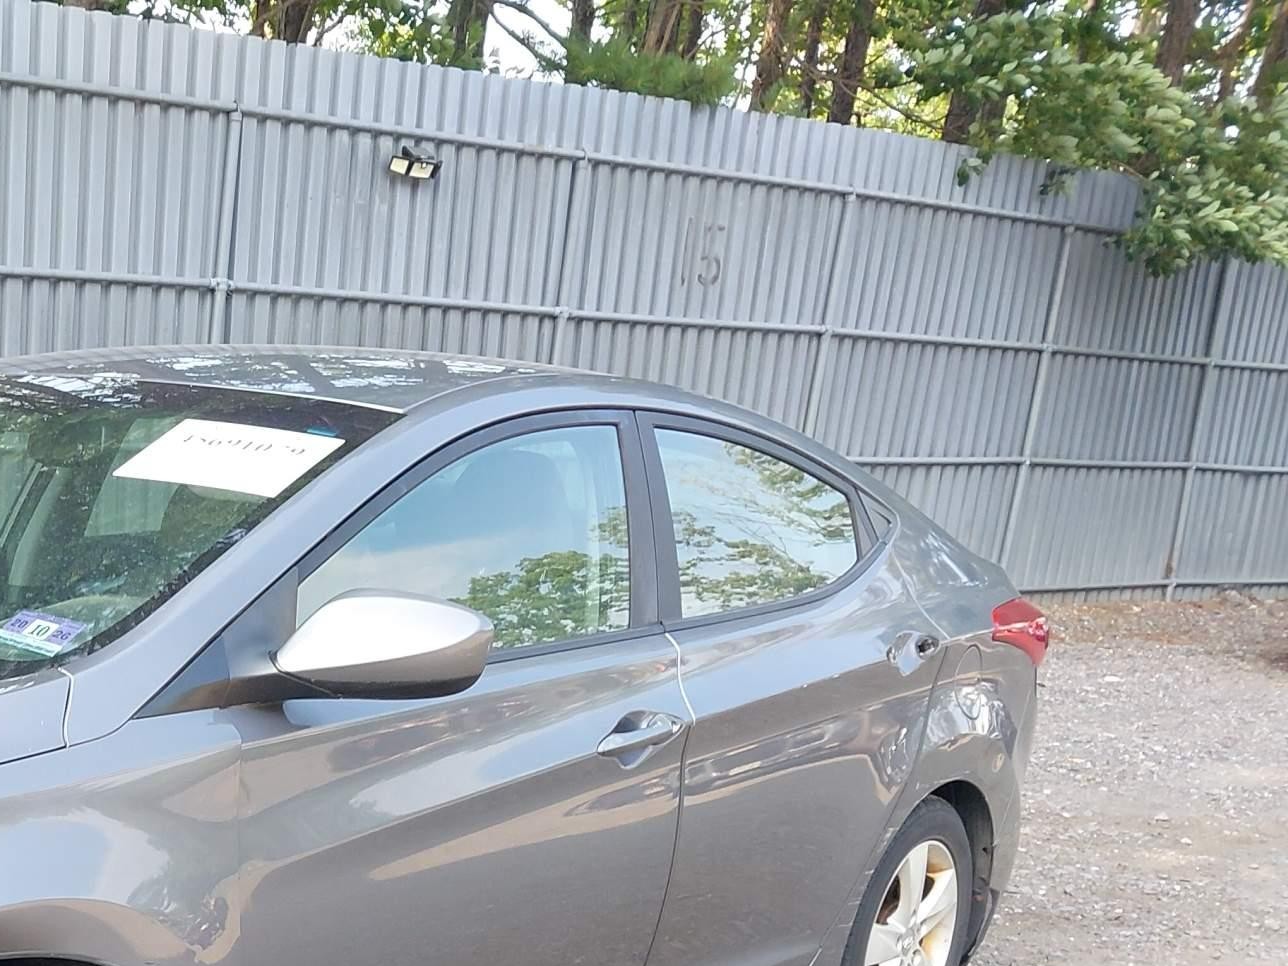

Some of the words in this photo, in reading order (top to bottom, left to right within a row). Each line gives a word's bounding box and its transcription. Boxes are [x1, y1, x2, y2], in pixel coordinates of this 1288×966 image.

[11, 618, 28, 629] 20
[27, 623, 50, 637] 10
[51, 630, 71, 640] 26
